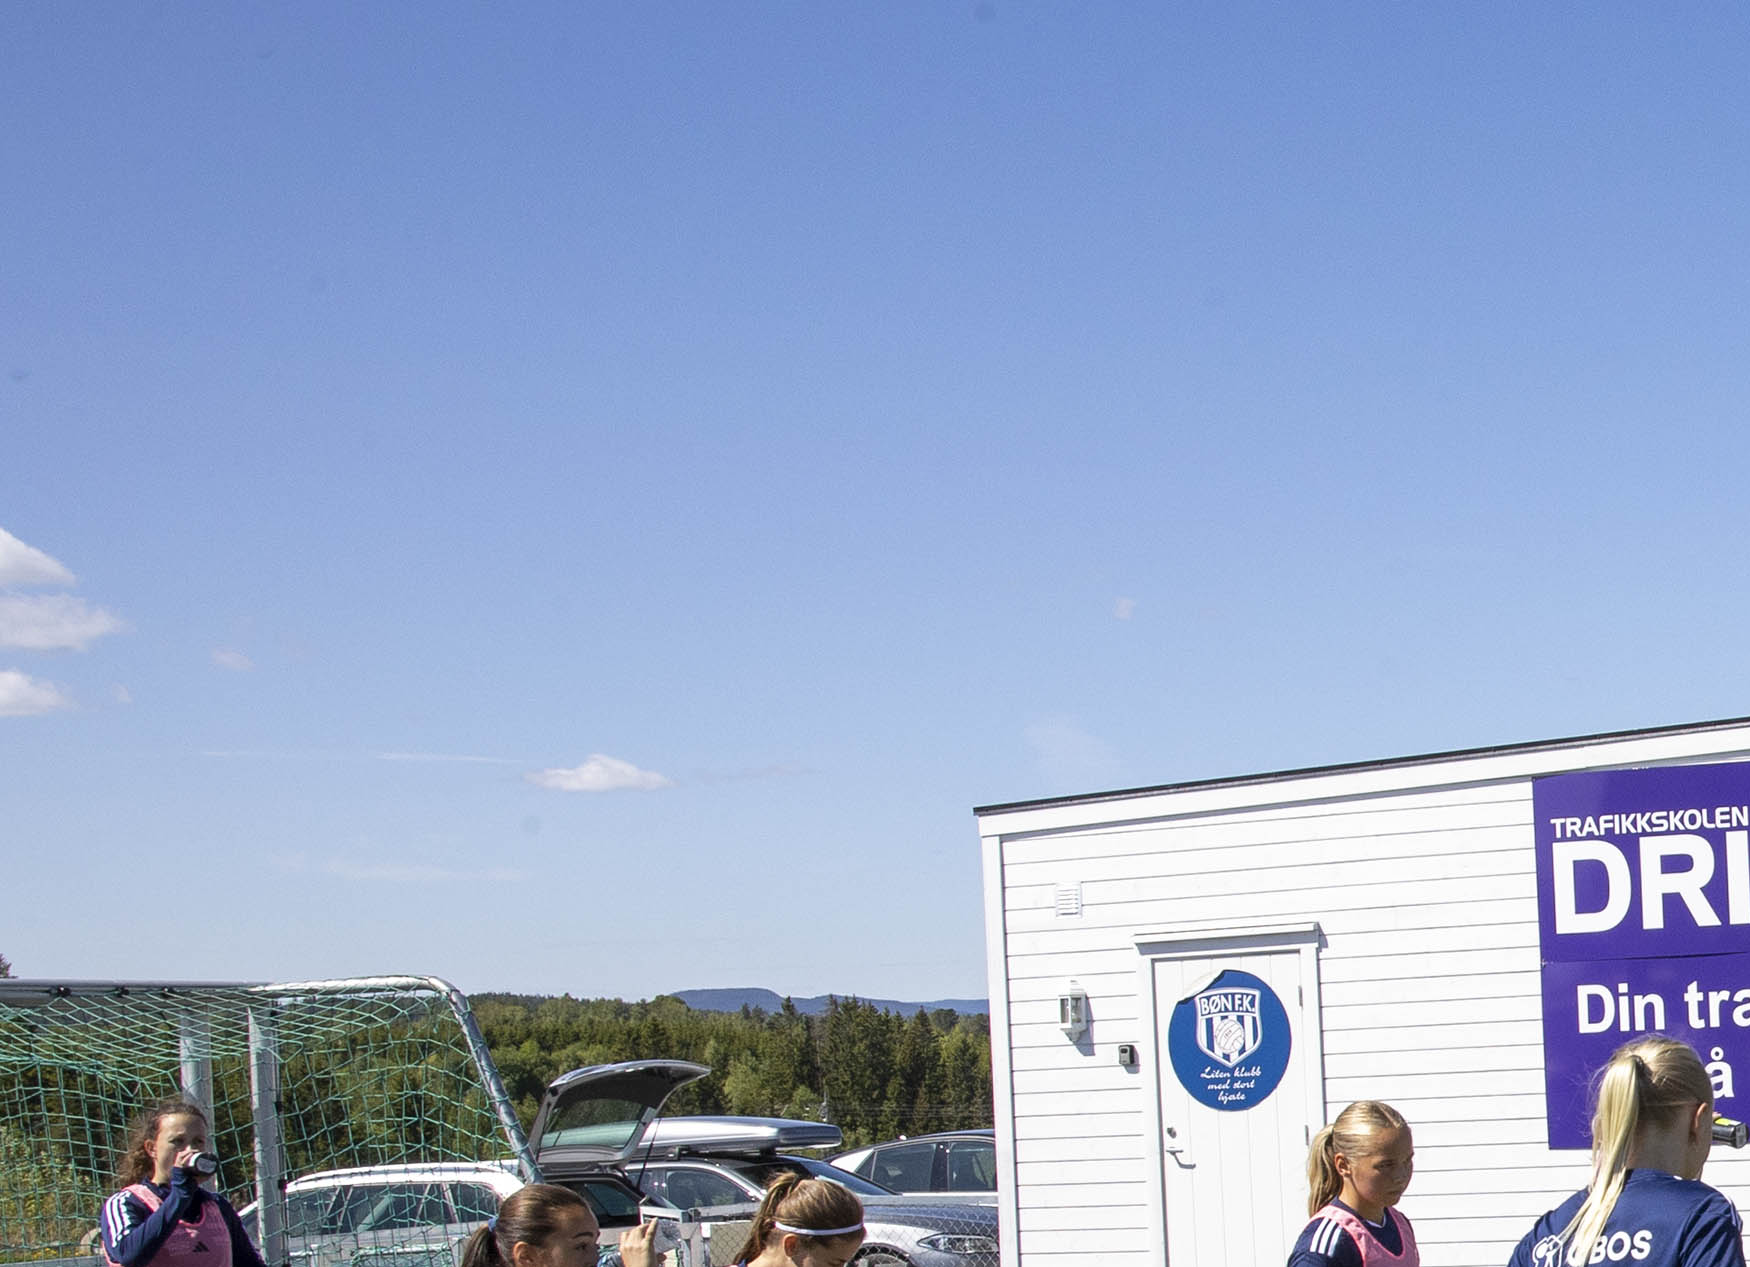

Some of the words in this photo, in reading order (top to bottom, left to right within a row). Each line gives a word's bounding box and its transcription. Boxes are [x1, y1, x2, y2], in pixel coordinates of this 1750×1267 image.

[1549, 805, 1749, 839] TRAFIKKSKOLEN
[1200, 994, 1232, 1015] BØN
[1235, 994, 1256, 1013] F.K.
[1576, 981, 1666, 1034] Din
[1200, 1066, 1232, 1079] Liten
[1234, 1066, 1262, 1077] klubb
[1208, 1080, 1231, 1090] med
[1233, 1080, 1255, 1089] stort
